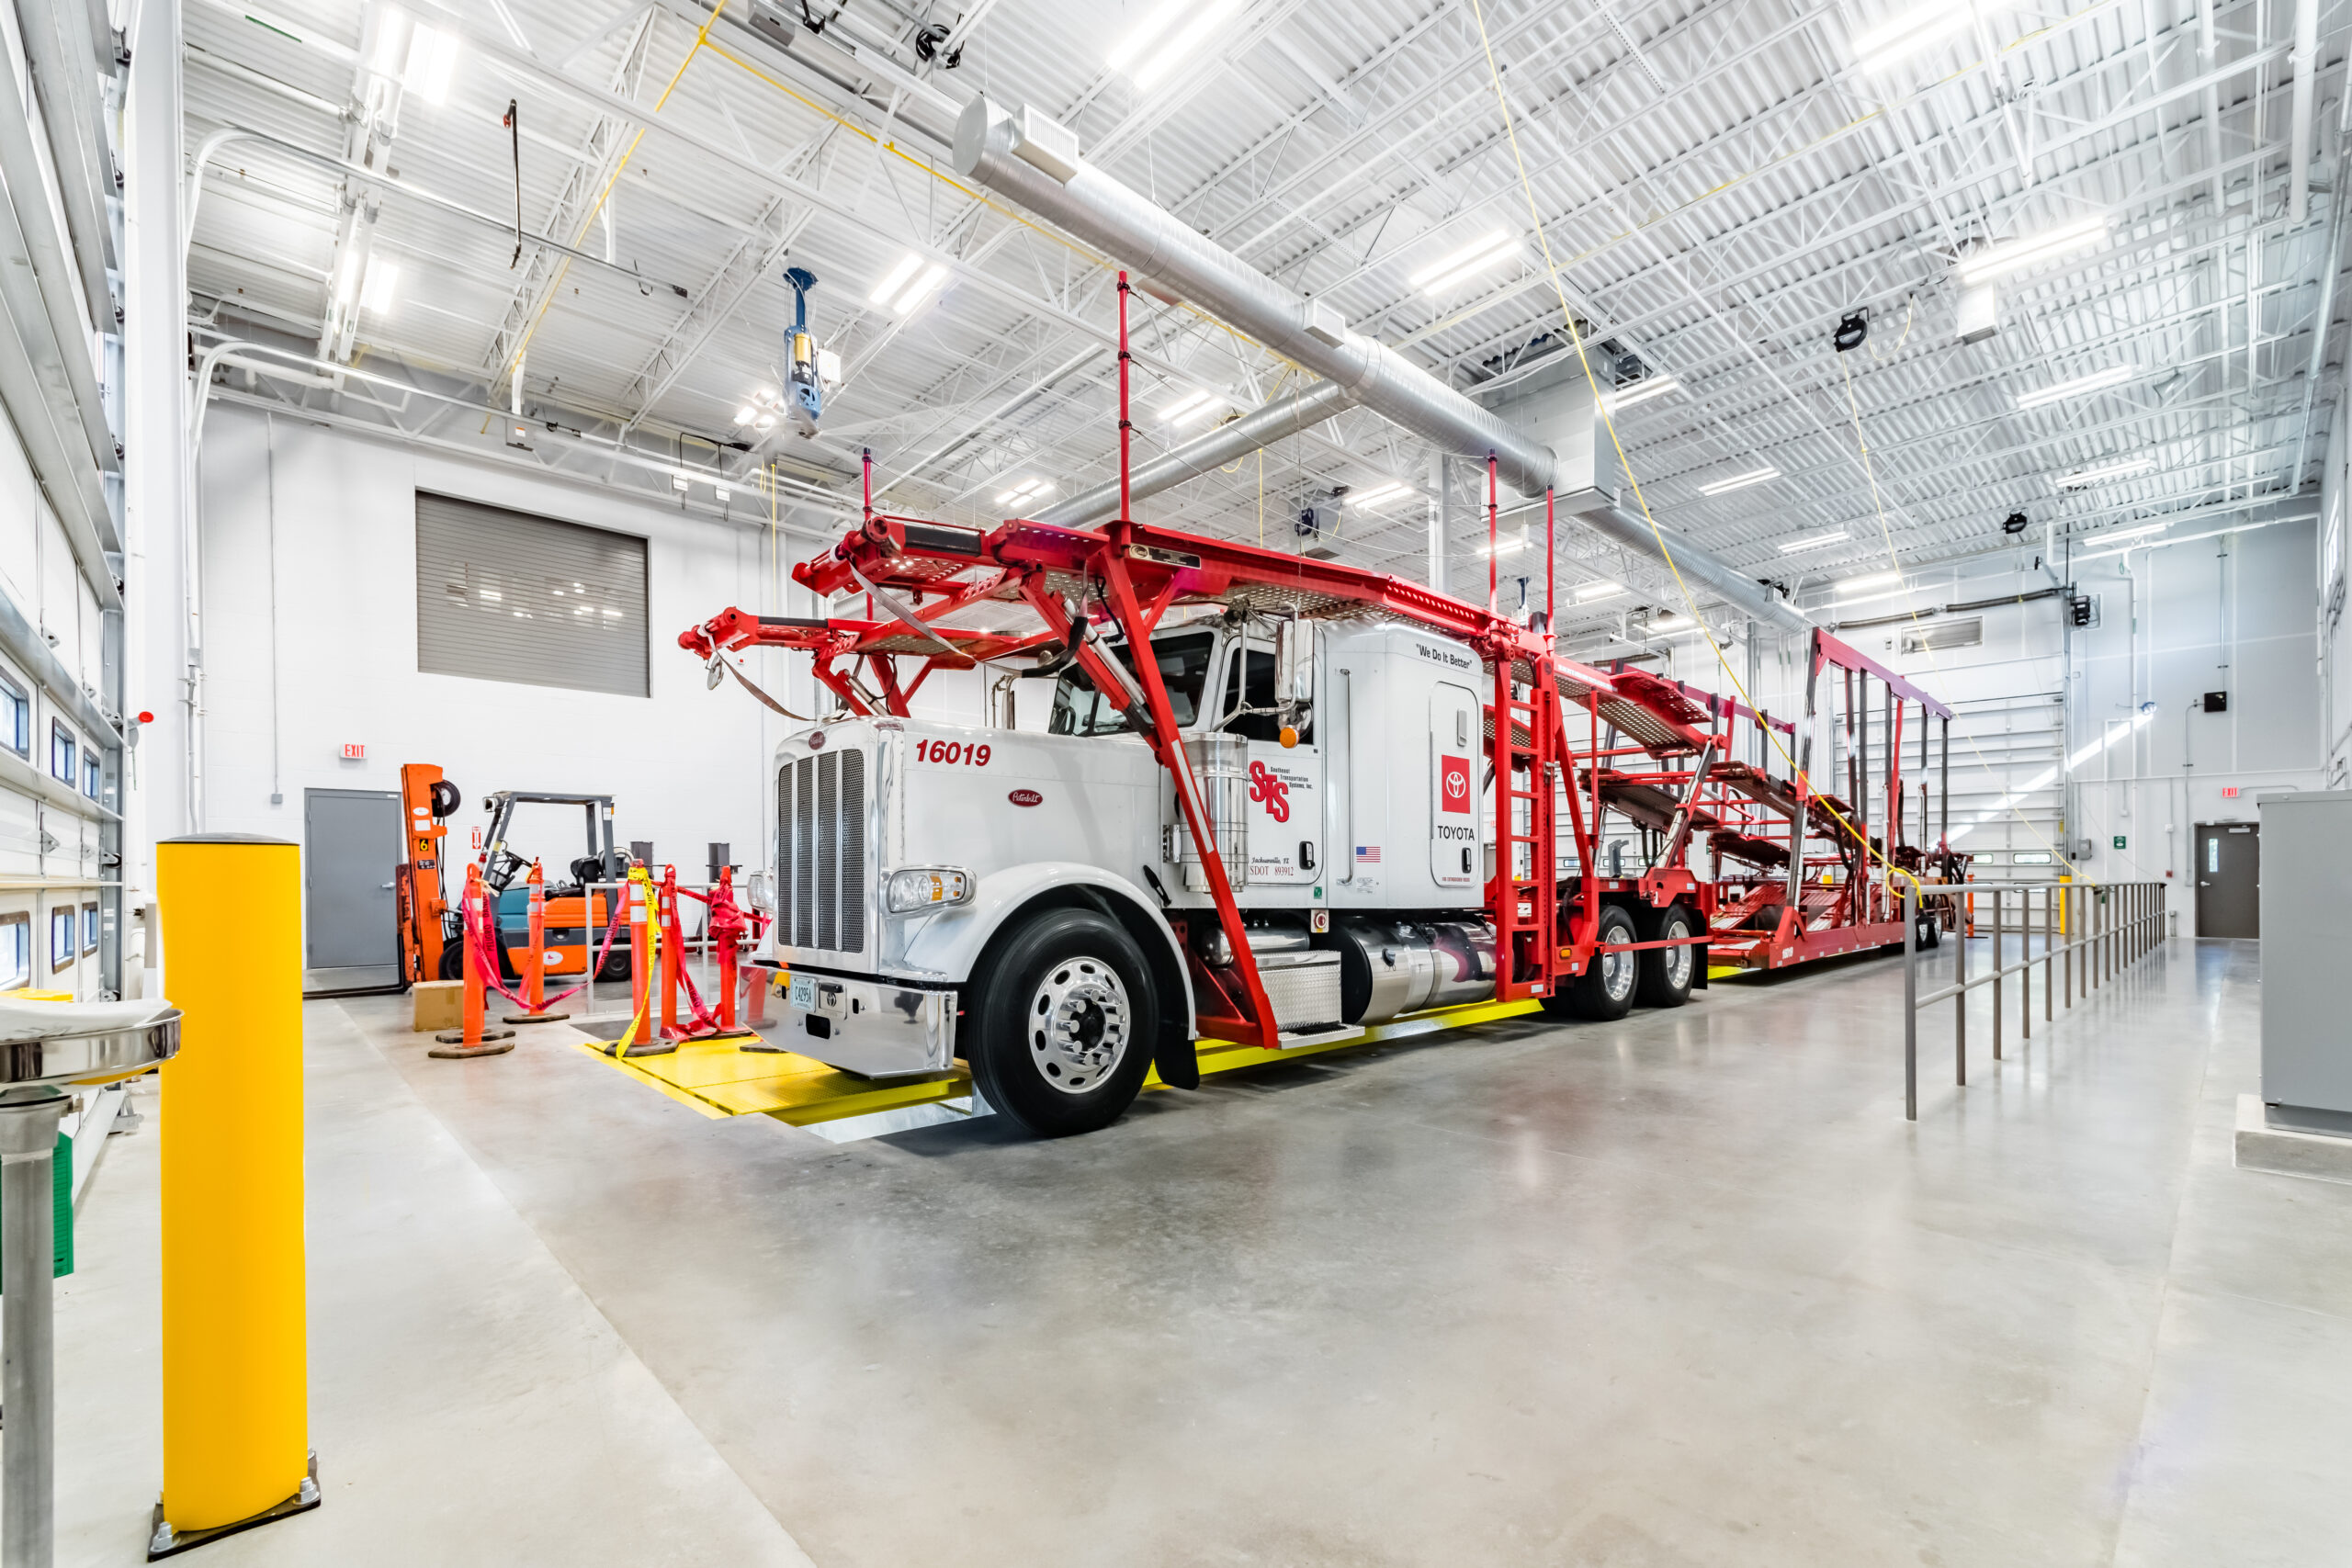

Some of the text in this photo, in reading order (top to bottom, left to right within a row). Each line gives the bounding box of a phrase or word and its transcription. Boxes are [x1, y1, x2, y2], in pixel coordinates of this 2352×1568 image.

[1416, 643, 1473, 669] "We Do It Better"
[345, 743, 366, 758] EXIT
[916, 739, 991, 767] 16019
[1280, 773, 1309, 783] Transportation
[1012, 791, 1041, 804] Peterbilt
[1250, 761, 1290, 823] STS
[2222, 787, 2238, 798] EXIT
[1437, 825, 1475, 841] TOYOTA
[420, 840, 428, 851] 6
[1249, 865, 1270, 875] SDOT
